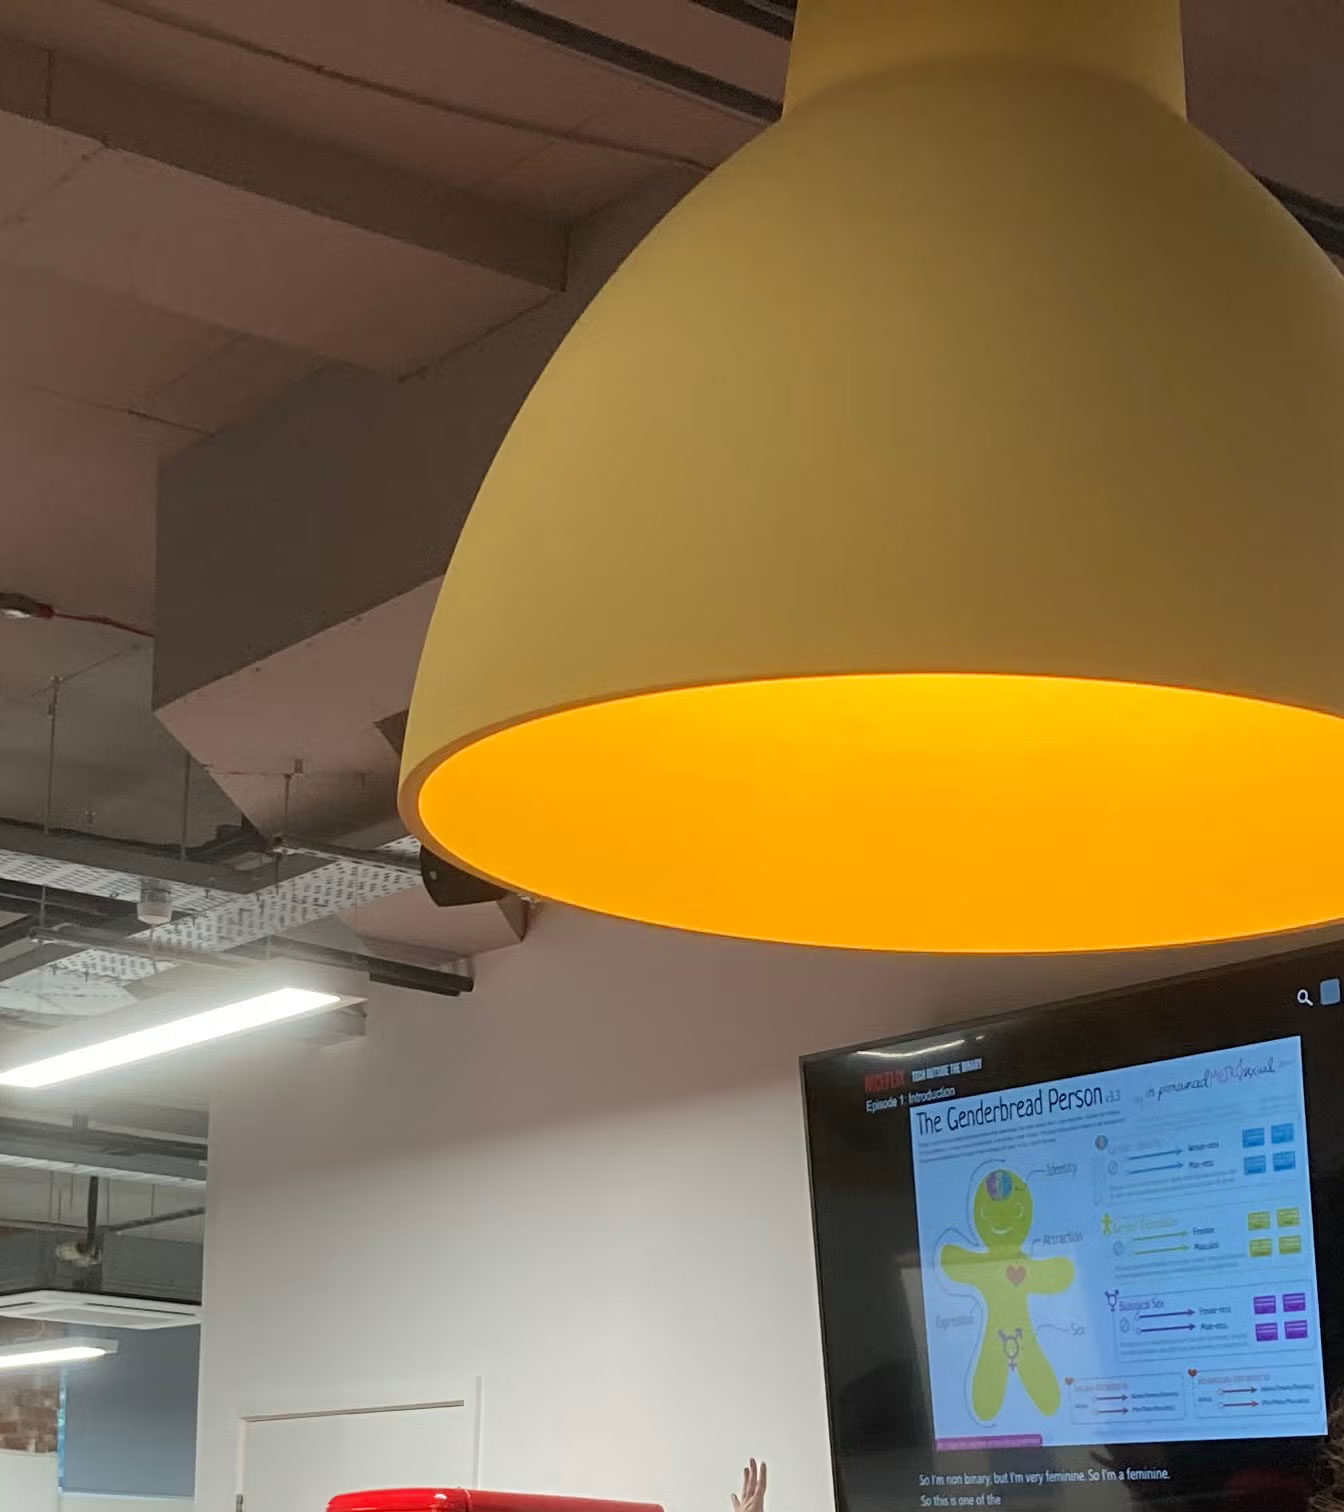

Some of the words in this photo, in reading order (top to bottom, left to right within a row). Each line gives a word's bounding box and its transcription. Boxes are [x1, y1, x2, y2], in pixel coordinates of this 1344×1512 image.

[908, 1086, 955, 1104] Introduction
[916, 1111, 942, 1136] The
[947, 1089, 1043, 1131] Genderbread
[1048, 1087, 1103, 1113] Person
[919, 1473, 930, 1486] So
[931, 1473, 945, 1485] I'm
[946, 1475, 963, 1485] non
[994, 1471, 1008, 1484] but
[1010, 1471, 1023, 1483] I'm
[1025, 1473, 1044, 1485] very
[1088, 1468, 1100, 1481] So
[1102, 1468, 1117, 1481] I'm
[1119, 1470, 1125, 1480] a
[920, 1494, 932, 1507] So
[933, 1494, 949, 1506] this
[950, 1496, 957, 1506] is
[958, 1496, 975, 1506] one
[976, 1493, 985, 1505] of
[986, 1493, 1001, 1505] the
